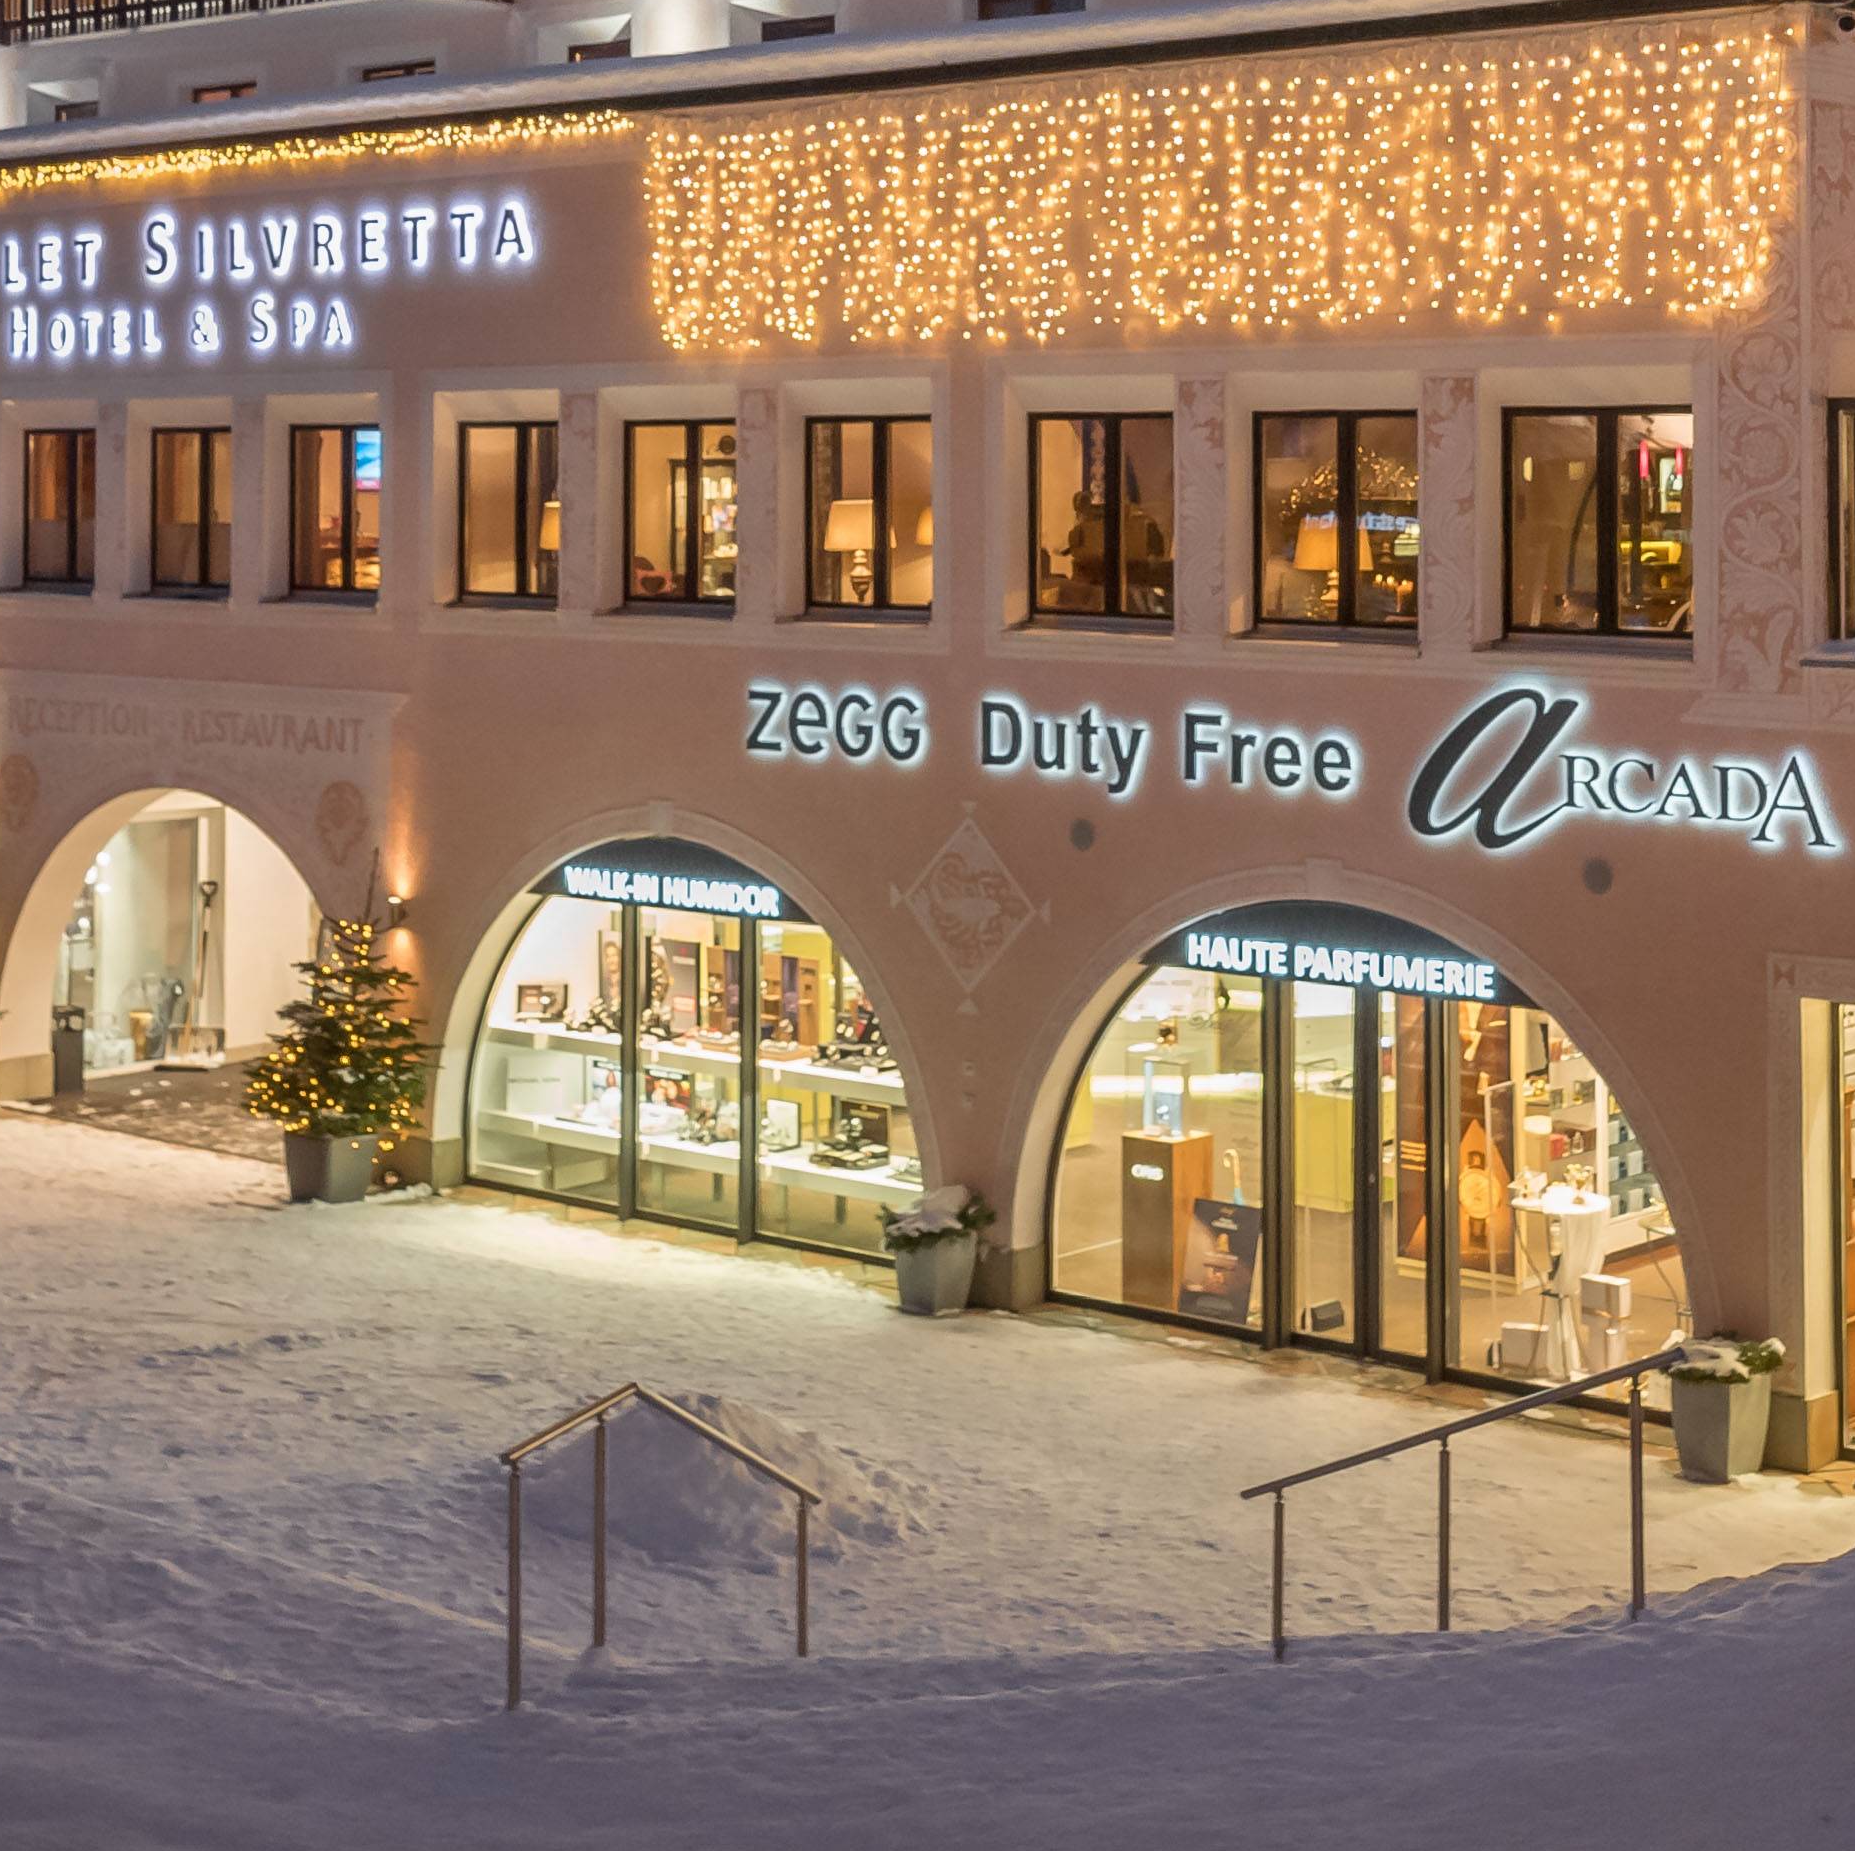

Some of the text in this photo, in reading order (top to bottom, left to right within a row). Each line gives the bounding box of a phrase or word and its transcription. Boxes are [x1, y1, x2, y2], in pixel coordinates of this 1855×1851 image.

[144, 201, 534, 284] SILVRETTA
[9, 291, 352, 359] HOTEL & SPA
[7, 694, 146, 738] RECEPTION
[978, 696, 1149, 796] Duty
[1179, 710, 1354, 793] Free
[563, 865, 781, 918] WALK-IN HUMIDOR
[1186, 932, 1496, 1000] HAUTE PARFUMERIE
